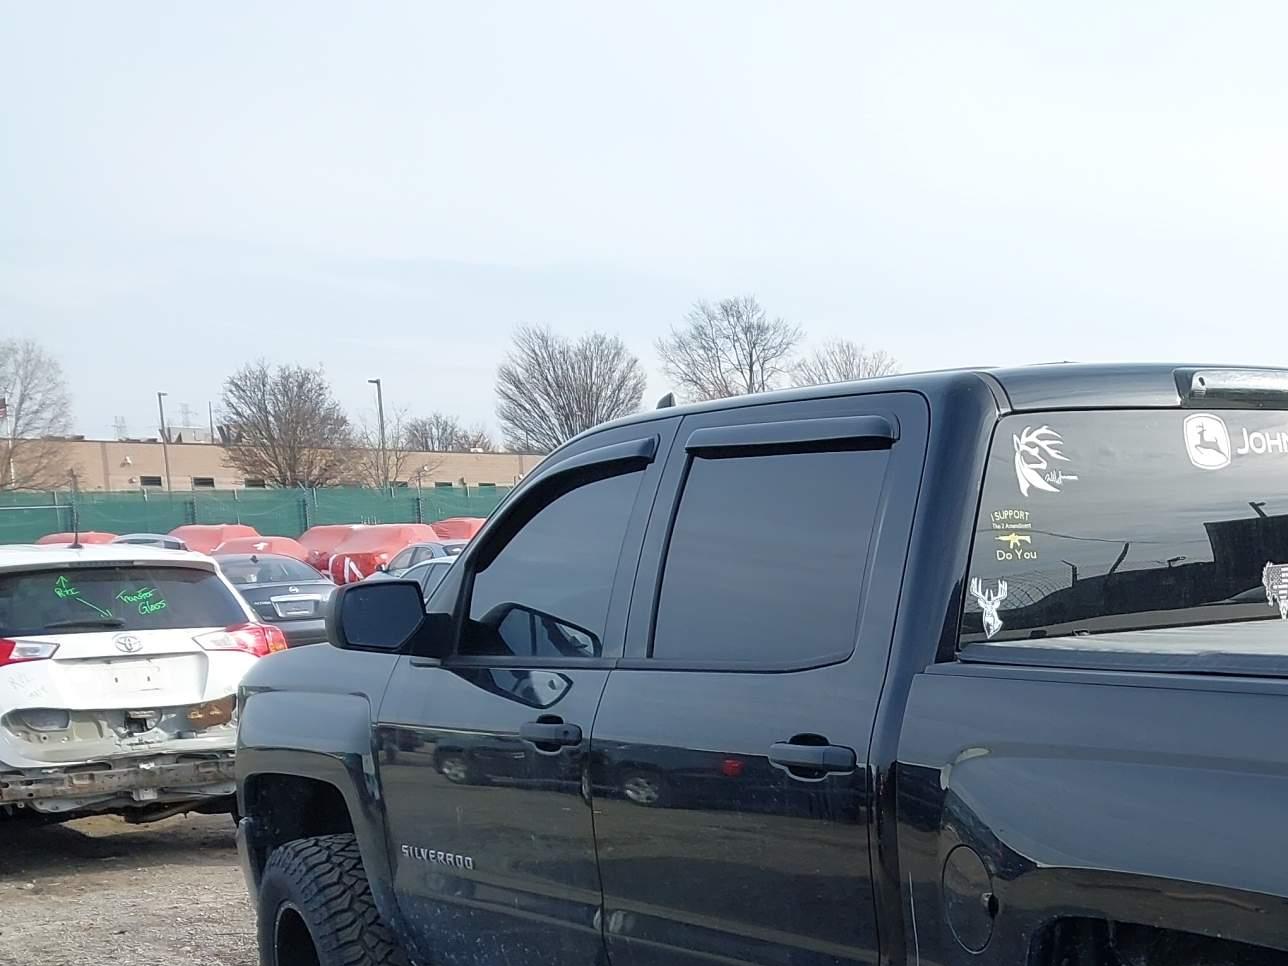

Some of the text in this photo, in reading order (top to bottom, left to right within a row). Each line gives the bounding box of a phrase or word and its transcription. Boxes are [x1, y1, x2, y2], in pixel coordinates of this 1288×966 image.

[994, 509, 1030, 521] SUPPORT
[996, 548, 1037, 561] Do You
[401, 844, 473, 870] SILVERADO
